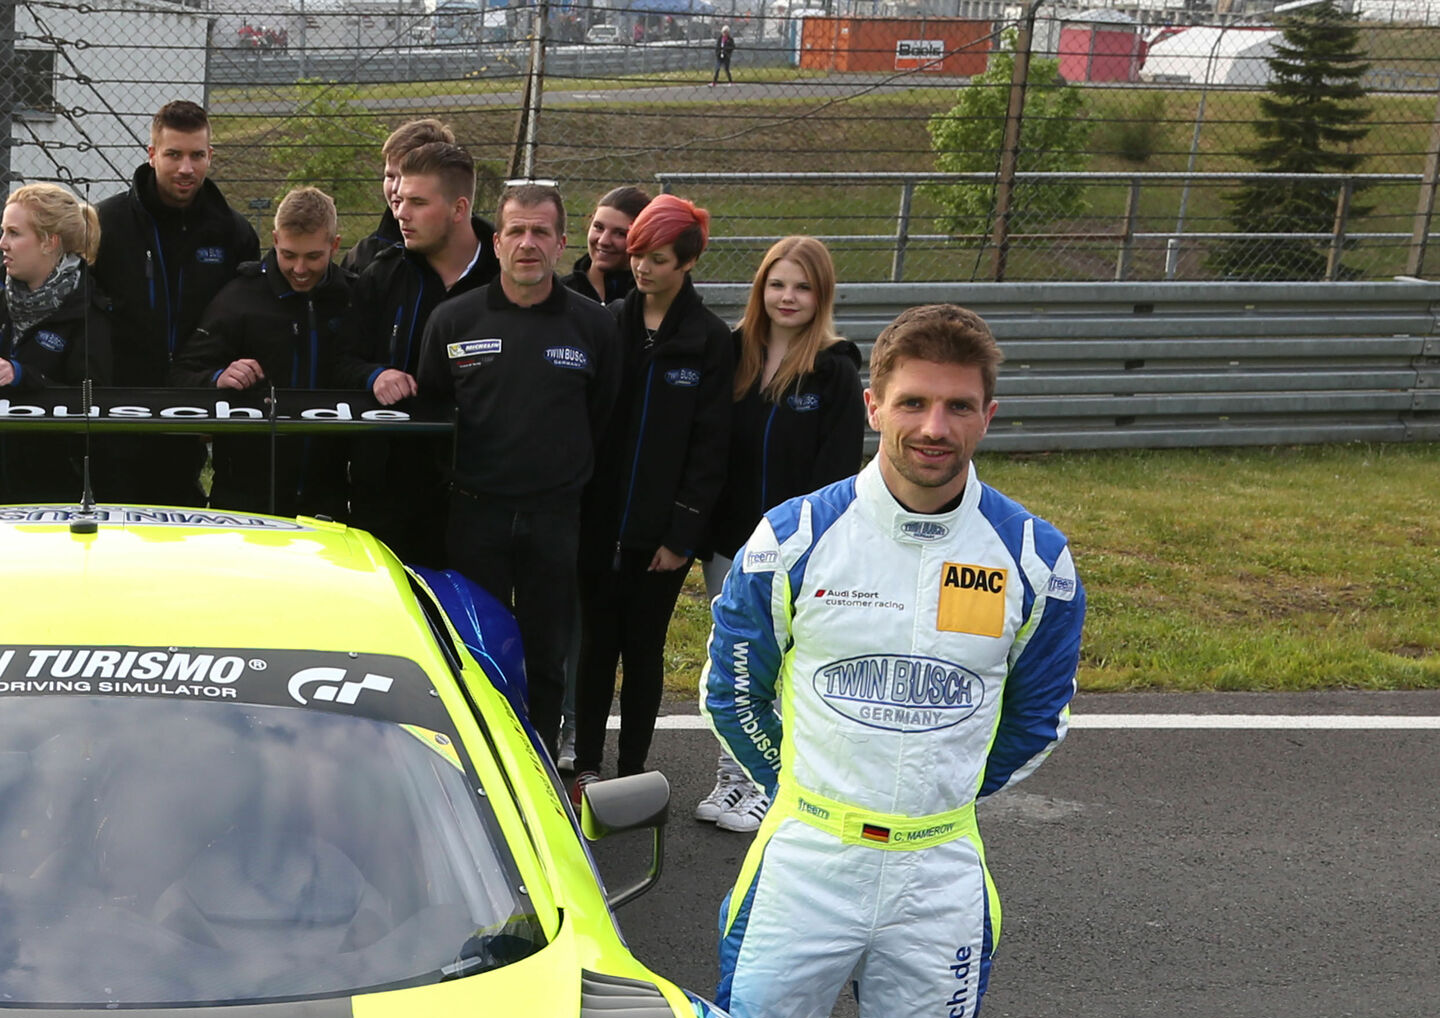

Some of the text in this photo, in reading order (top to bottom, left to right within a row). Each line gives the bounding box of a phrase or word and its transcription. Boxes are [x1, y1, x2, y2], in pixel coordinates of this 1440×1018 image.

[465, 342, 500, 352] MICHELIN
[546, 348, 563, 360] TWIN
[944, 566, 1004, 594] ADAC
[827, 589, 879, 600] Audi Sport
[825, 598, 905, 611] customer racing
[823, 657, 973, 706] TWIN BUSCH
[96, 682, 238, 699] SIMULATOR
[859, 705, 943, 727] GERMANY
[894, 822, 956, 842] C. MAMEROW
